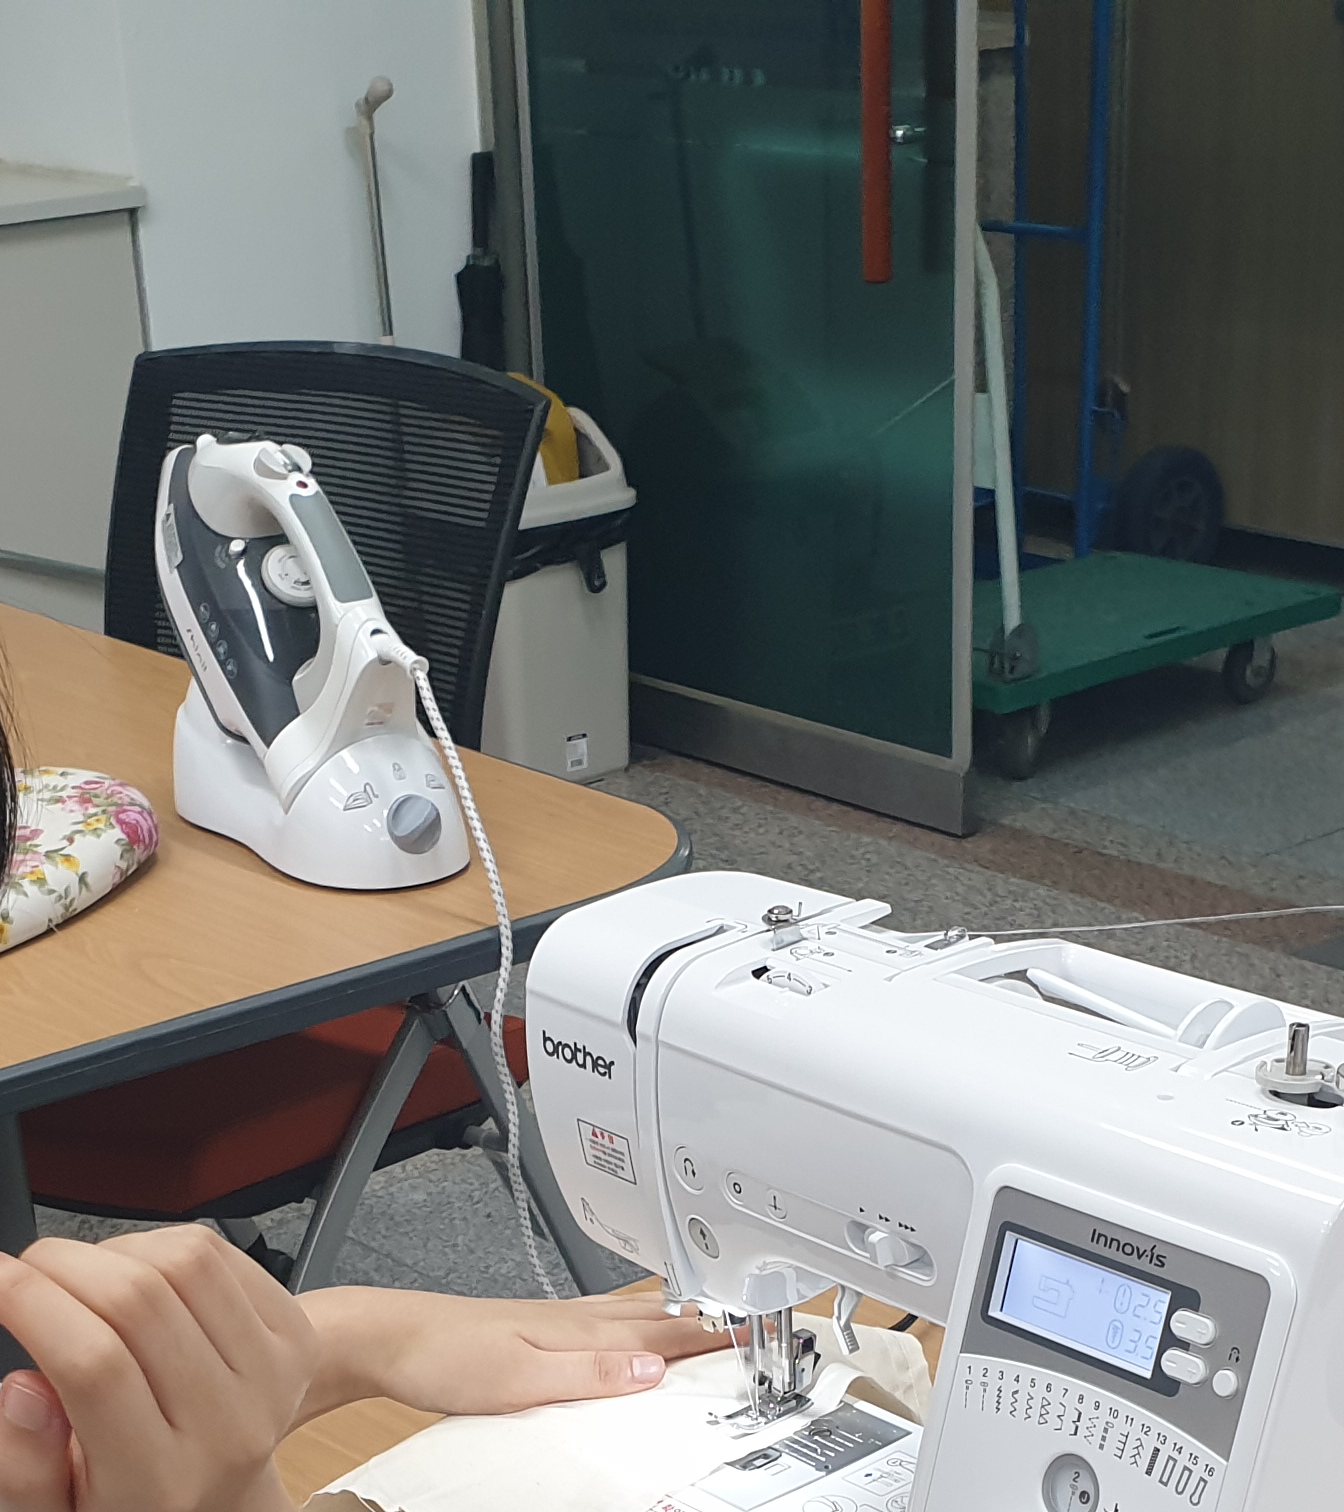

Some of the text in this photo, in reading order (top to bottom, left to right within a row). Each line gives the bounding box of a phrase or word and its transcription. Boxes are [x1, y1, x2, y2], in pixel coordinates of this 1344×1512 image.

[786, 972, 792, 982] 4
[542, 1029, 615, 1080] brother
[967, 1365, 1215, 1477] 1 2 3 4 5 6 7 8 9 10 11 12 13 14 15 16
[1072, 1471, 1080, 1483] 2
